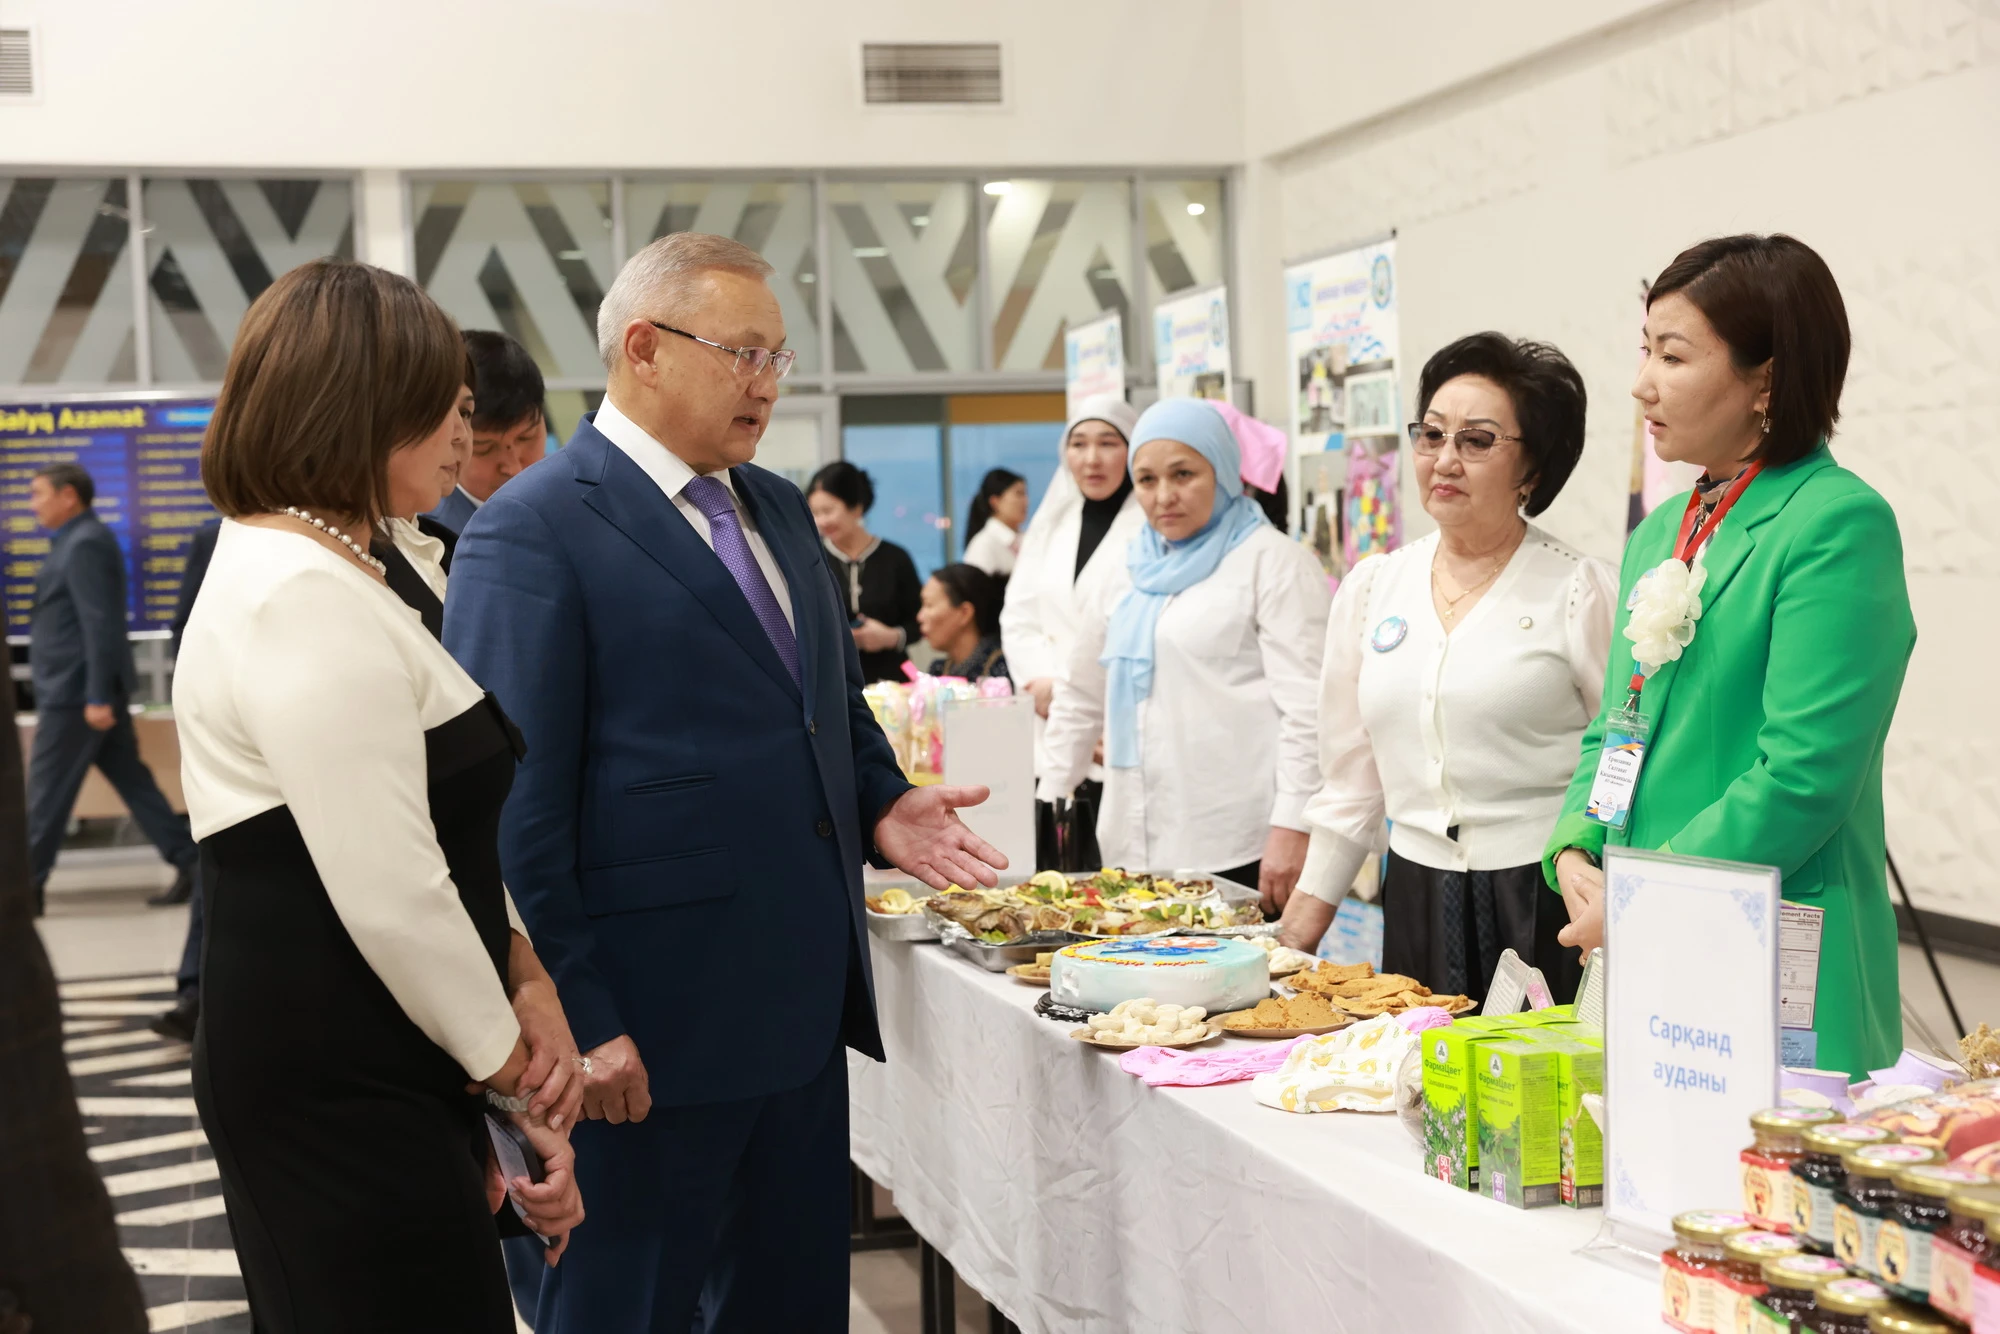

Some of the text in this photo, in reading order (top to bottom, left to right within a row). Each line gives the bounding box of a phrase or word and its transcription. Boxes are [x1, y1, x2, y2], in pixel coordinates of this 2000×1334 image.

[58, 407, 145, 428] Azamat
[1649, 1014, 1732, 1059] Сарқанд
[1424, 1059, 1461, 1076] ФармаЦвет
[1653, 1061, 1726, 1095] ауданы
